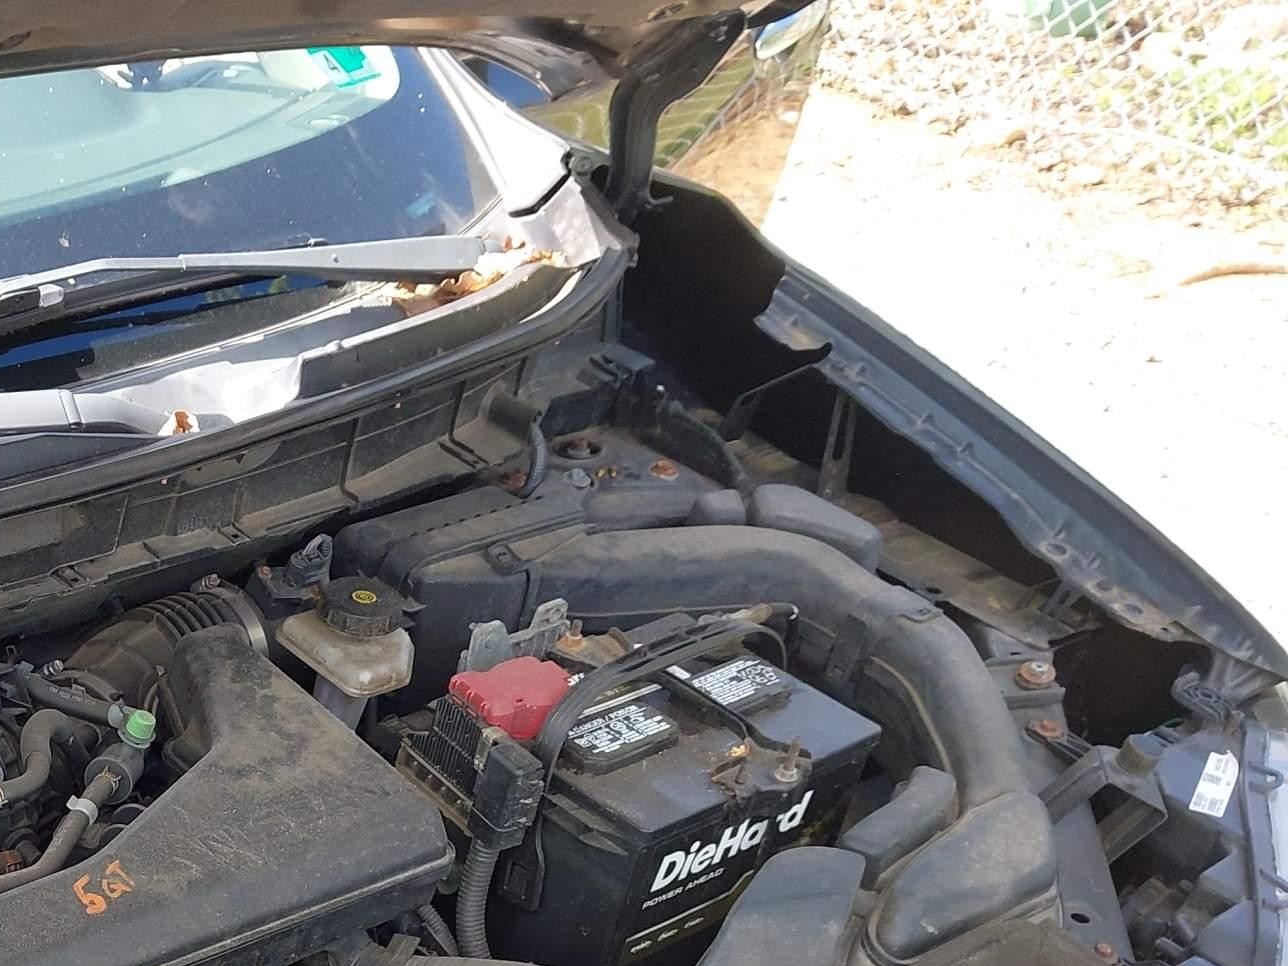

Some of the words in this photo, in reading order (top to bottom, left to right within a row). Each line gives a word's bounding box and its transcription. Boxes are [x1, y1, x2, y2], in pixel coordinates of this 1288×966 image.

[649, 789, 815, 893] DieHad
[642, 886, 684, 910] POWER
[684, 867, 727, 891] AHEAD
